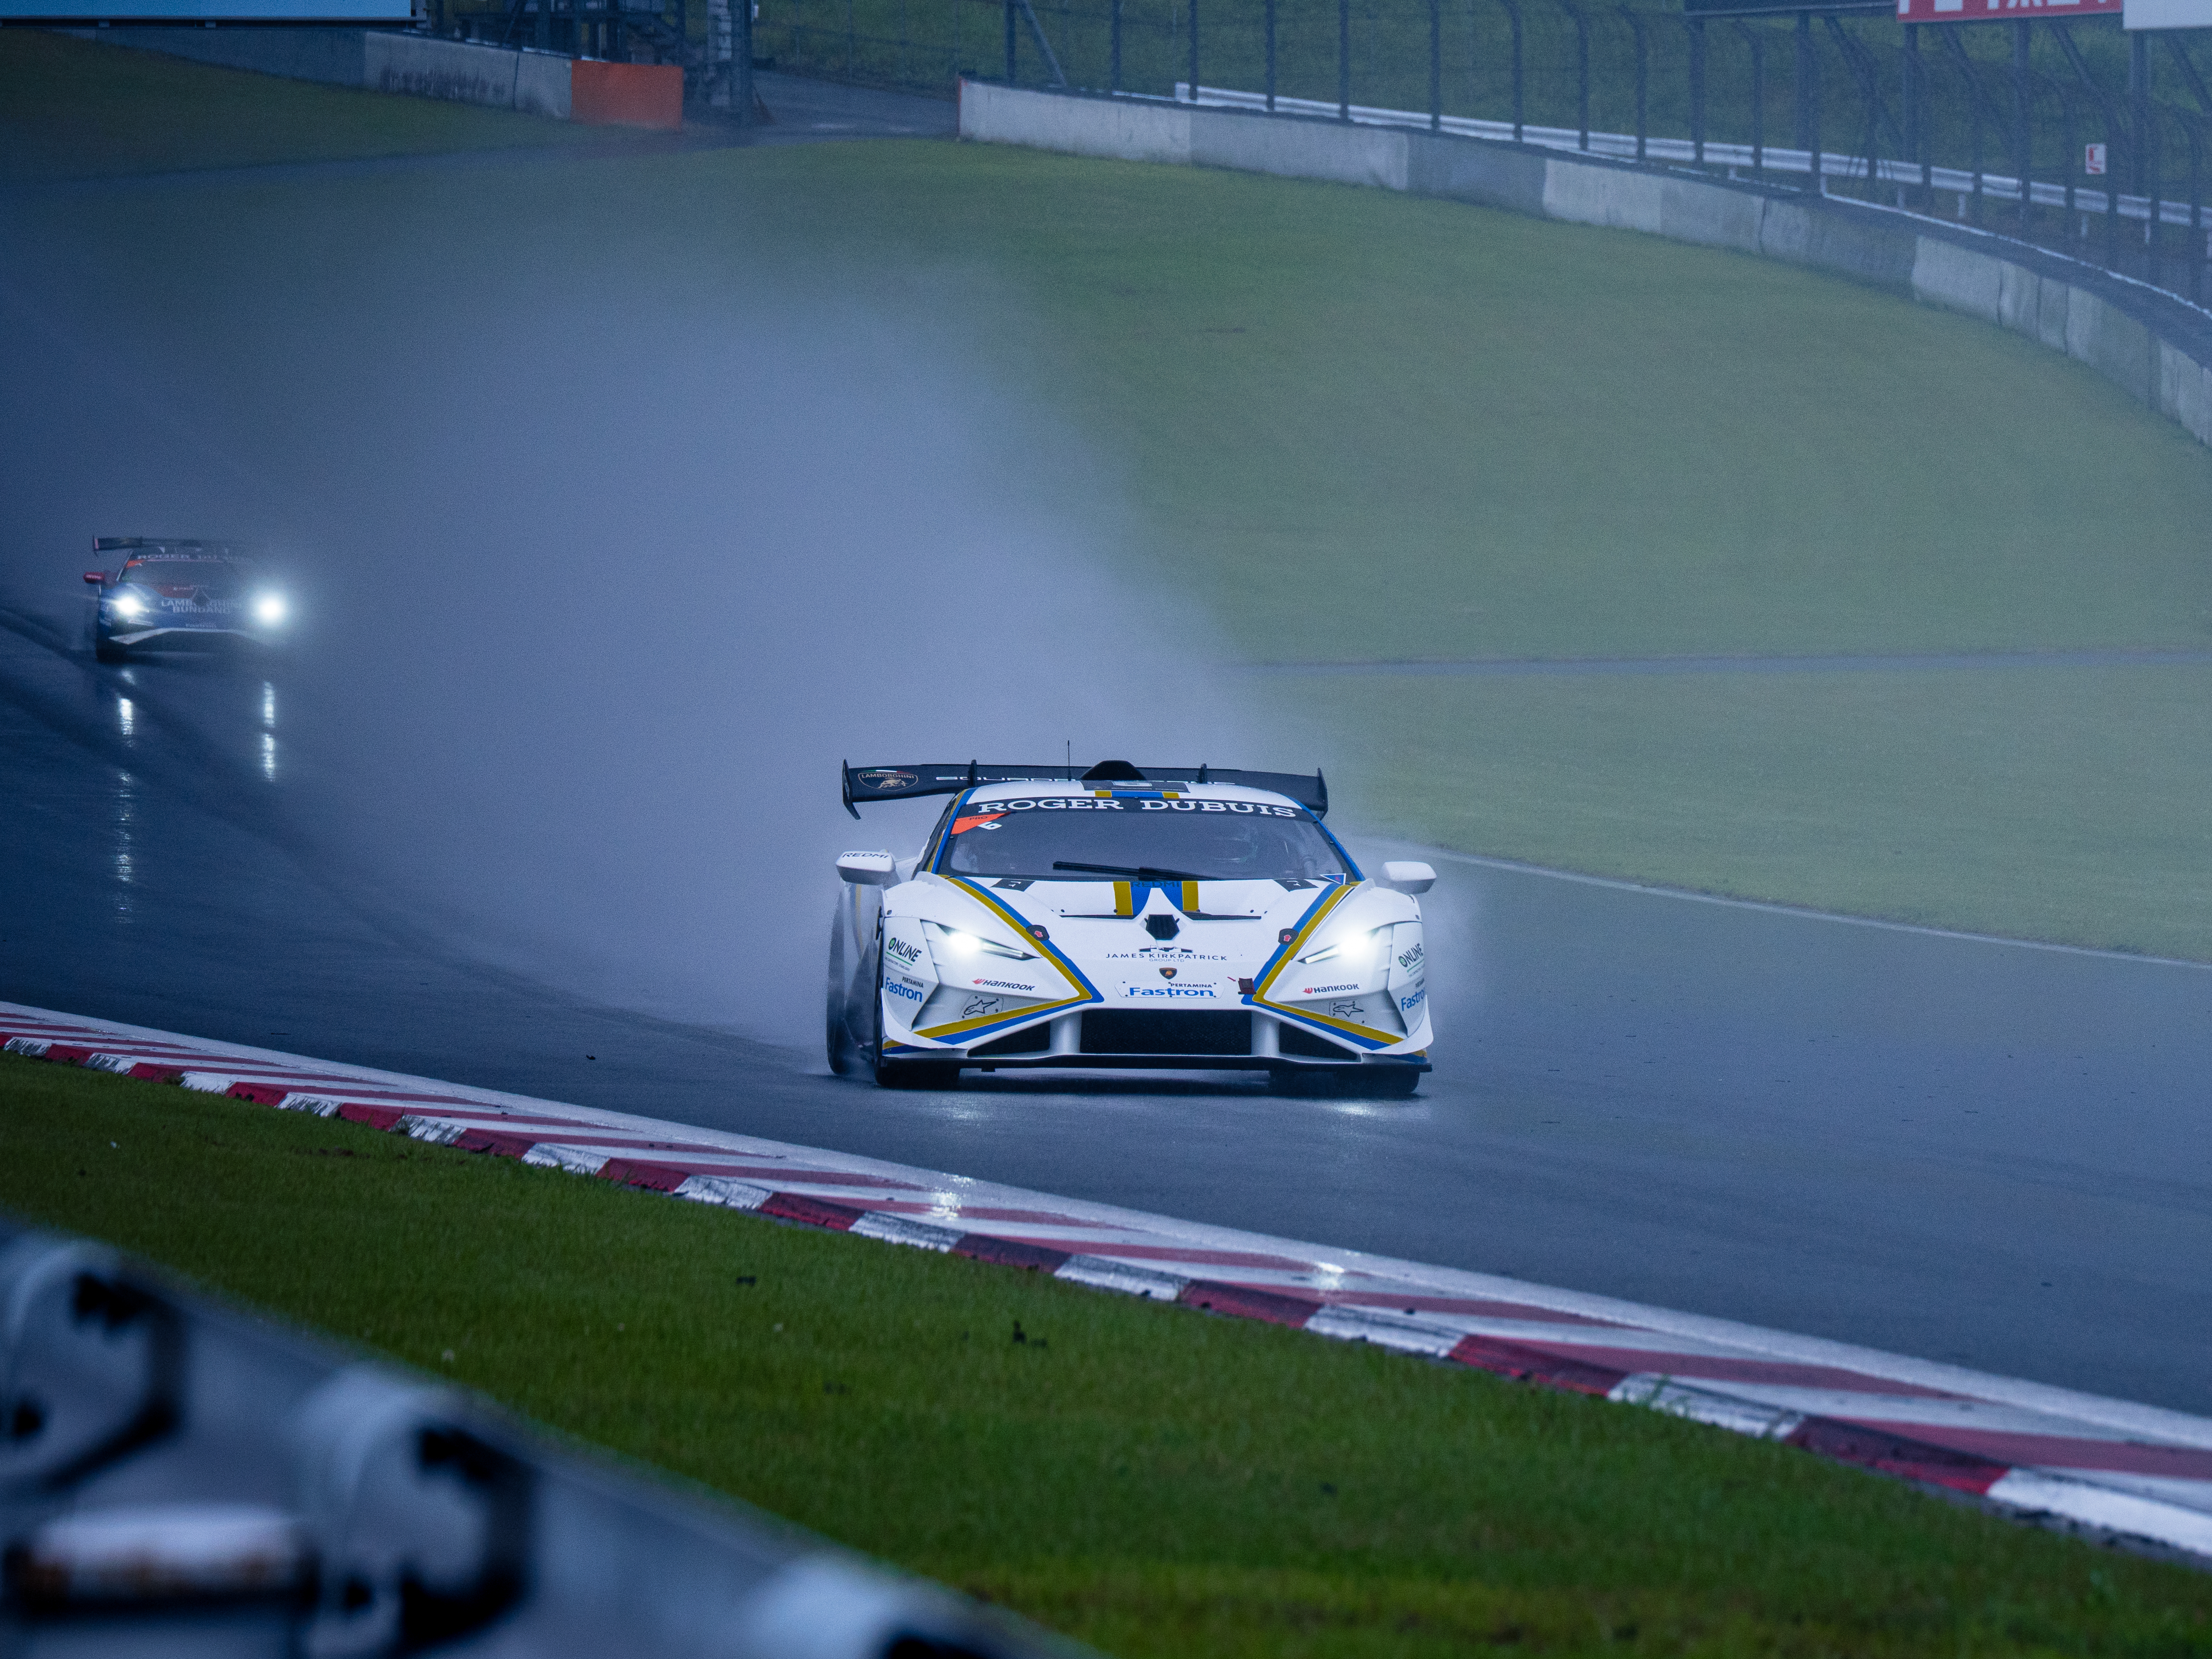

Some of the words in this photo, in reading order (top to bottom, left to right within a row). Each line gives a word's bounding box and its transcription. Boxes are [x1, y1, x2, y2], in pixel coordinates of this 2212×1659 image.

[978, 799, 1124, 813] ROGER
[1140, 800, 1296, 817] DUBUIS
[888, 937, 922, 962] ONLINE
[1399, 943, 1423, 968] ONLINE
[886, 977, 923, 1002] Fastron
[902, 976, 924, 988] PERTAMINA
[1129, 987, 1214, 997] Fastron
